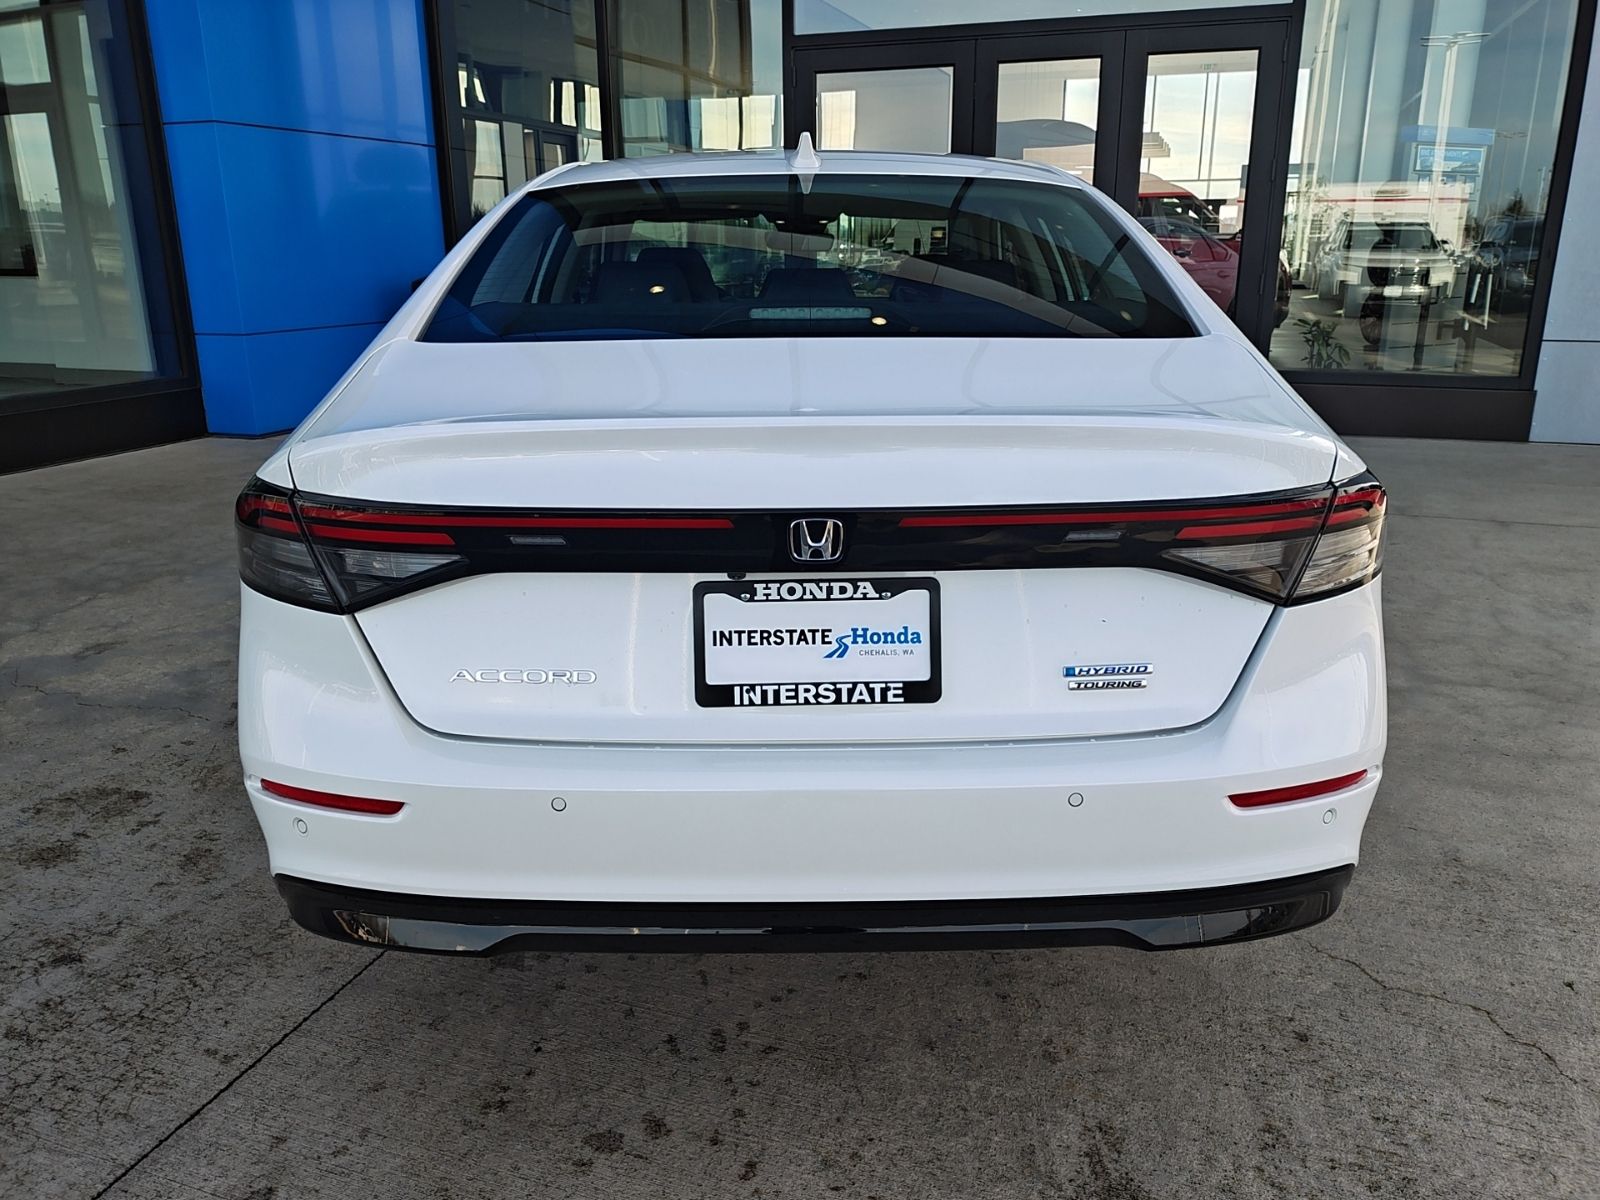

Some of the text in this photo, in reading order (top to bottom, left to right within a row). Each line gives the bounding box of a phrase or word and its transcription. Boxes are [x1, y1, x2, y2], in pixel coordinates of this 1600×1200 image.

[753, 582, 879, 600] HONDA
[712, 626, 922, 646] INTERSTATE Honda
[449, 669, 597, 684] ACCORD
[1078, 665, 1148, 675] HYBRID
[1075, 681, 1142, 689] TOURING
[734, 683, 905, 705] INTERSTATE
